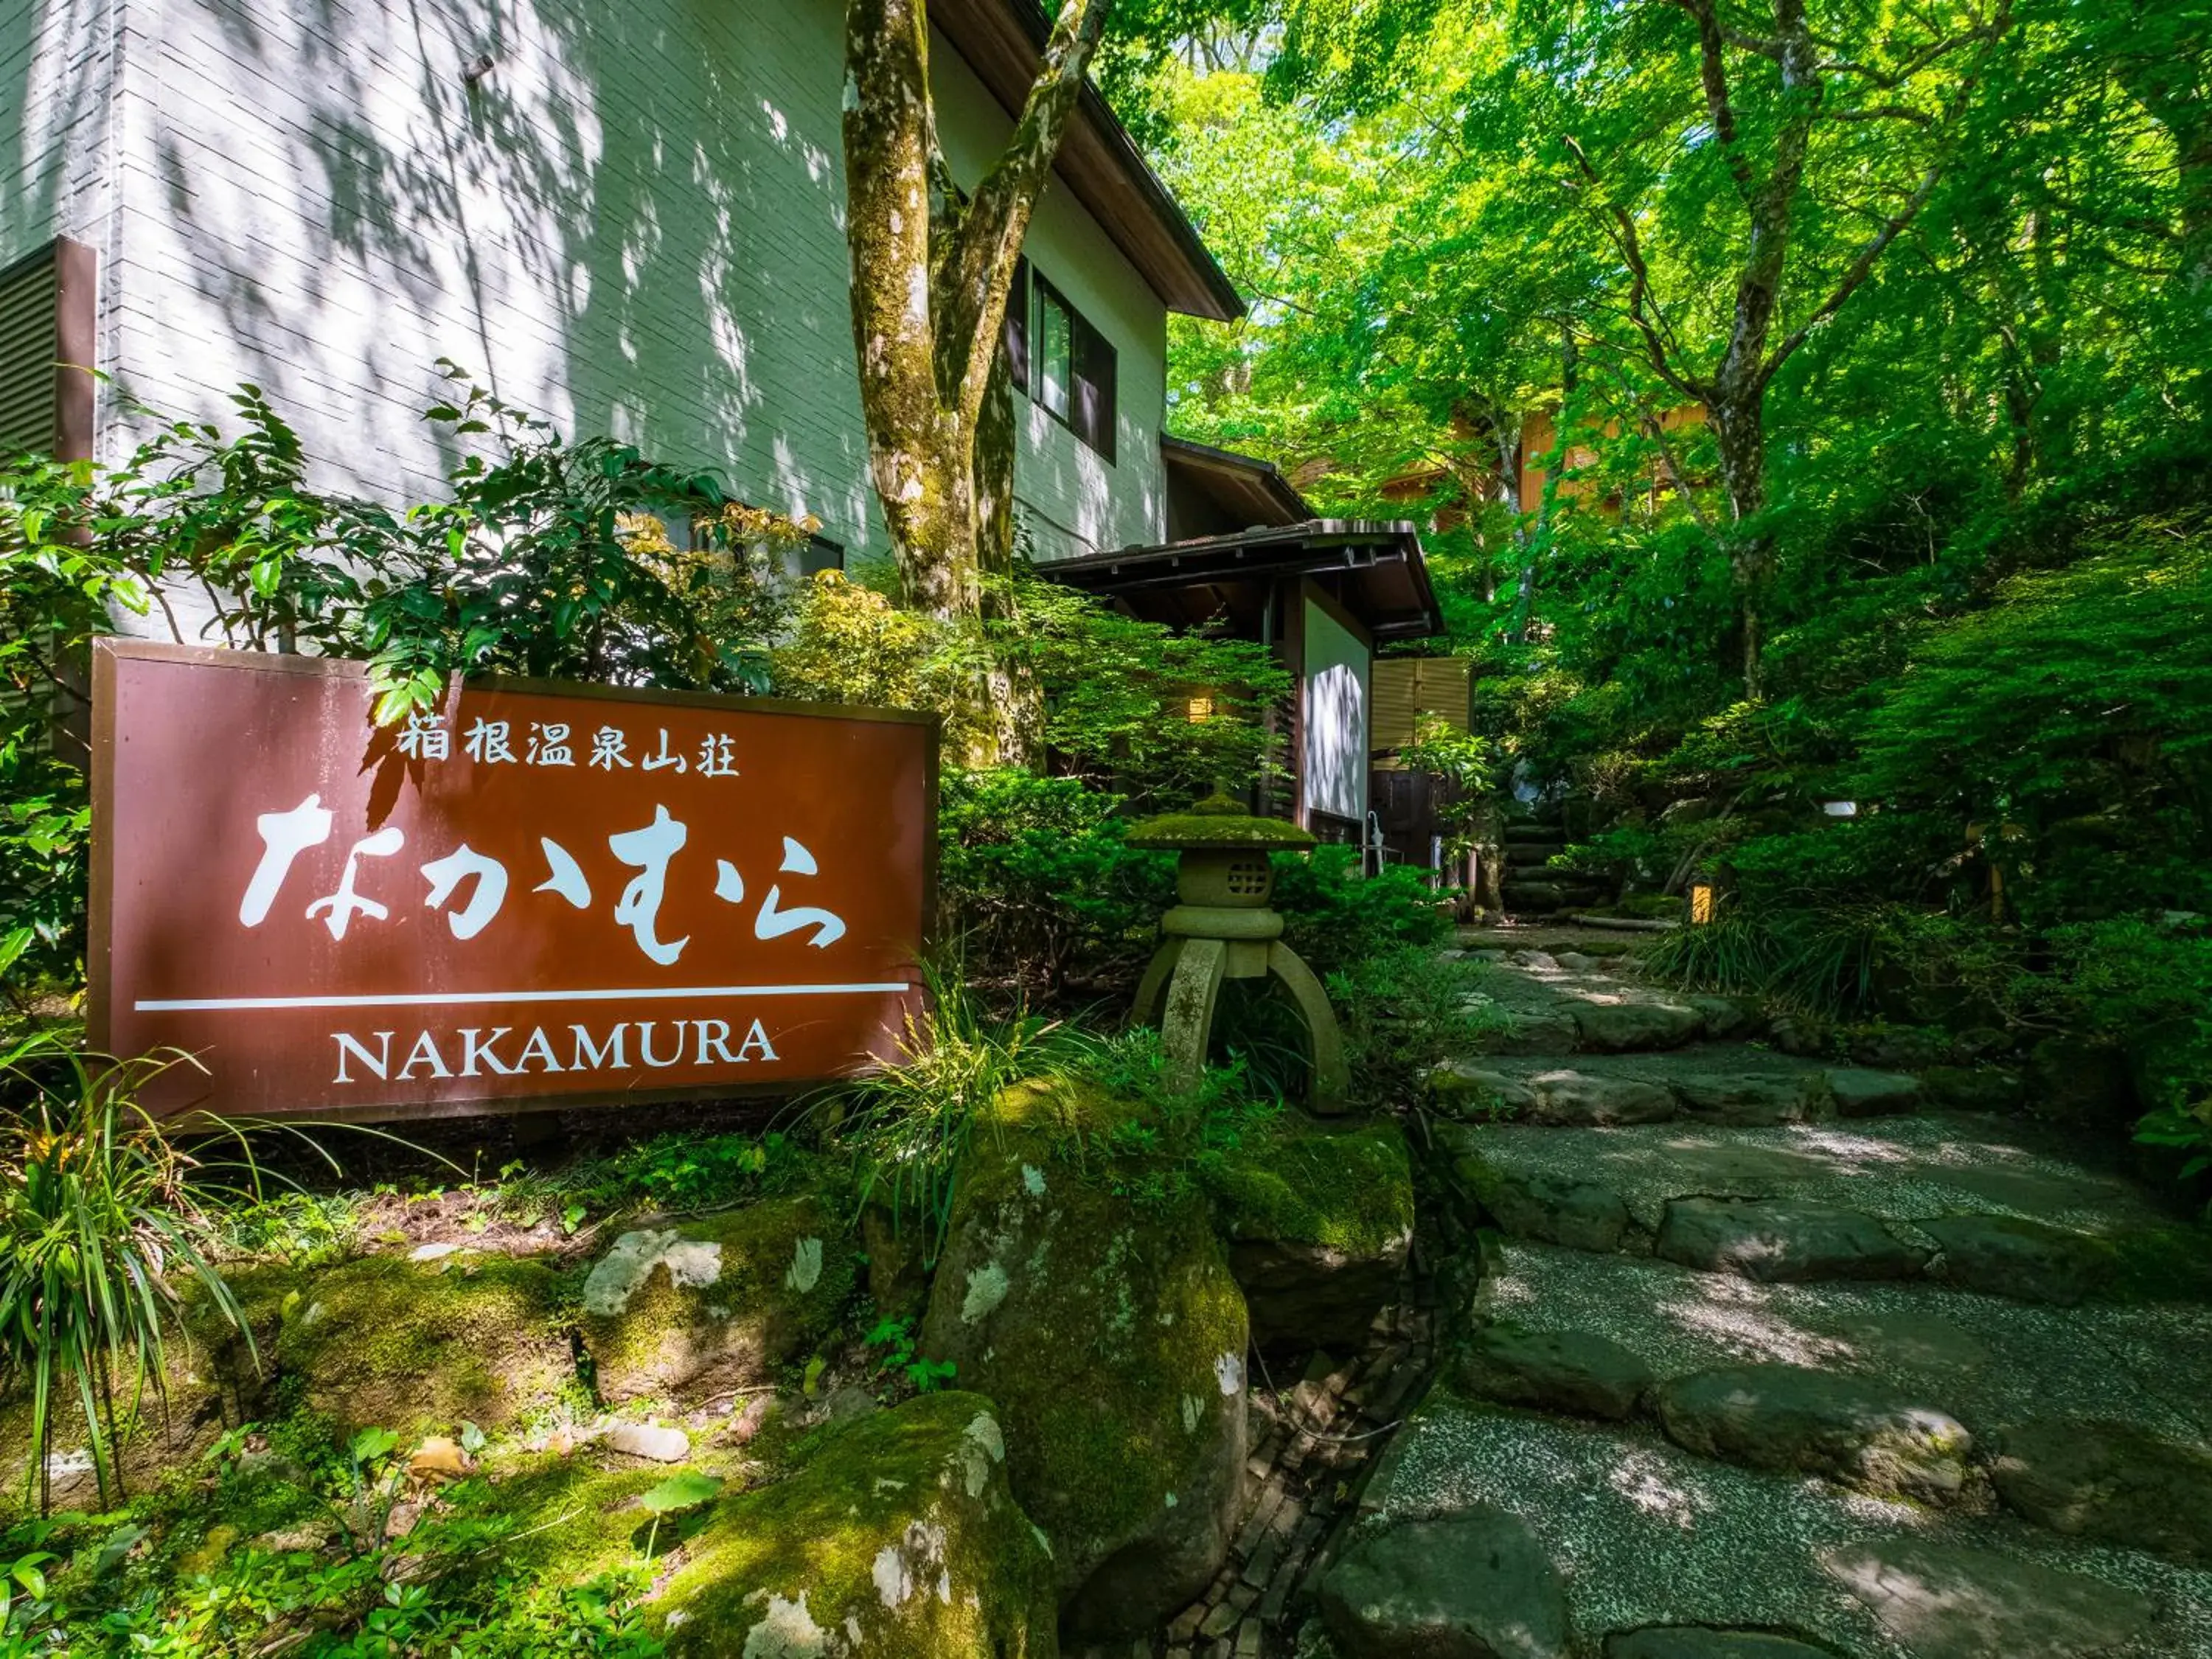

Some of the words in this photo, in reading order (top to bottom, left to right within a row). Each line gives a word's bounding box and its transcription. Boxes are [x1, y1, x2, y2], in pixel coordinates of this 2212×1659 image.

[397, 711, 740, 779] 箱根温泉山荘
[240, 794, 846, 965] なかむら
[331, 1018, 780, 1084] NAKAMURA
